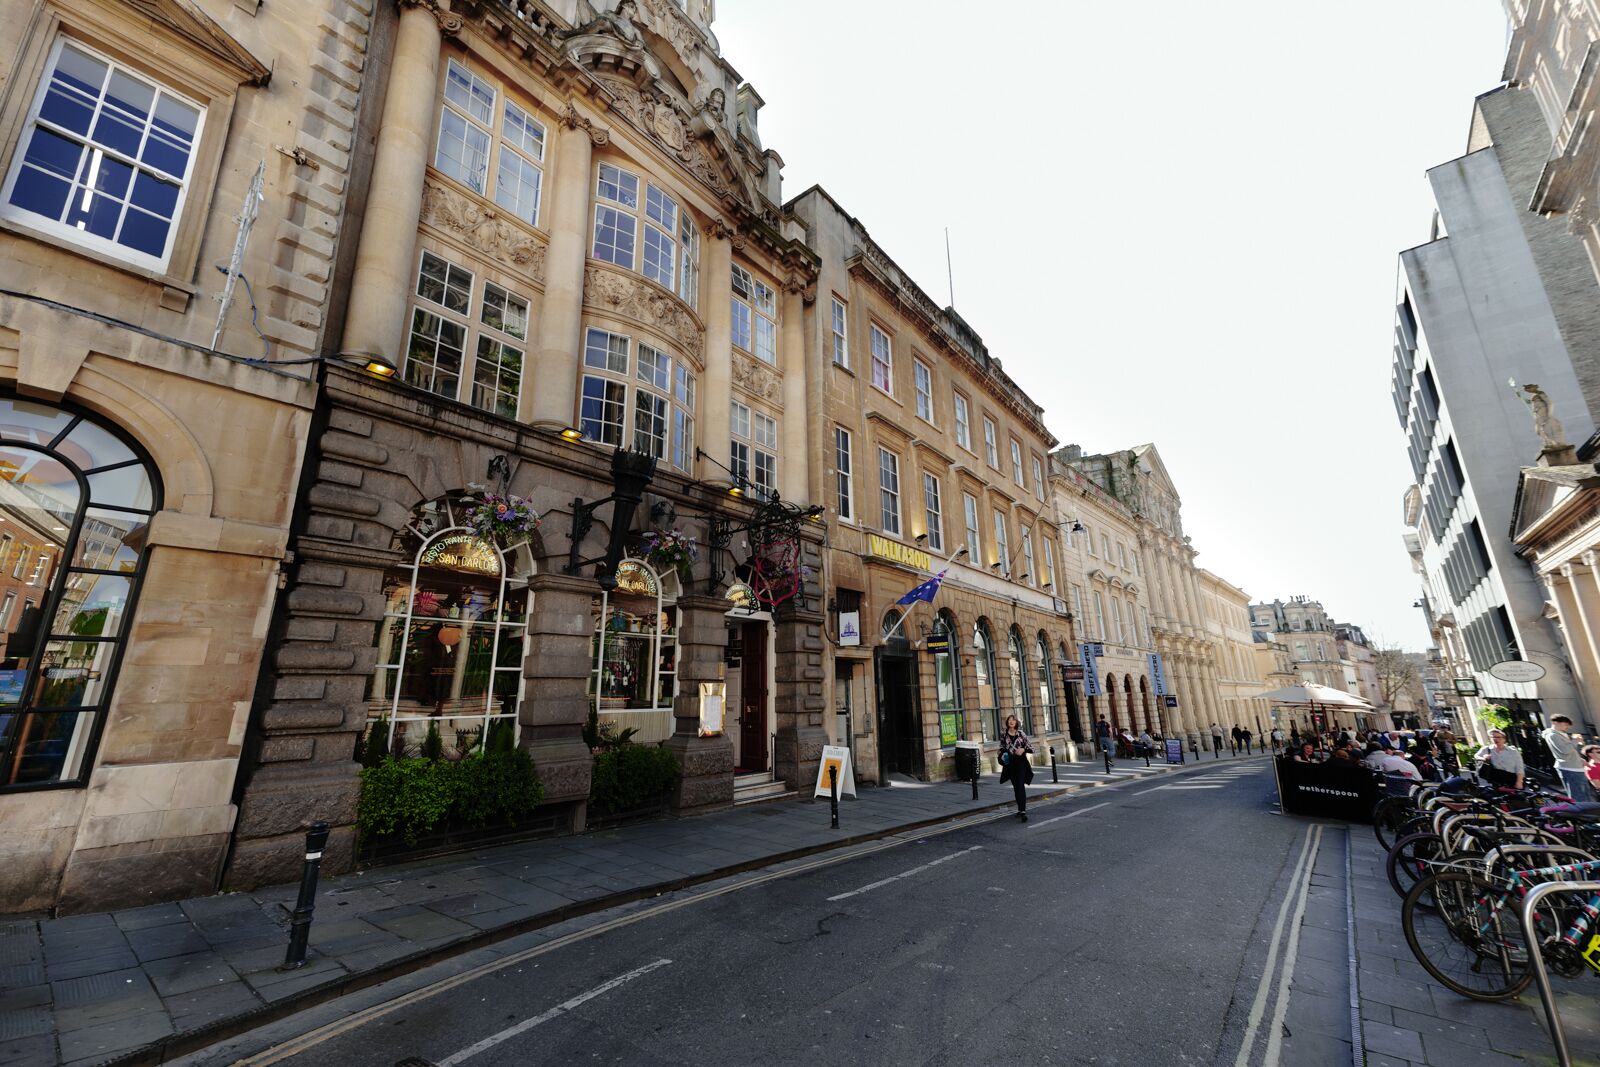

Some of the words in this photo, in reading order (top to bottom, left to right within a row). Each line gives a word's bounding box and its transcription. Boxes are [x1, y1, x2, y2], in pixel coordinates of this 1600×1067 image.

[439, 552, 458, 565] SAN
[461, 556, 489, 570] CARLO
[871, 535, 930, 572] WALKABOUT
[617, 578, 629, 589] SAN
[630, 580, 650, 591] CARLO
[1083, 645, 1091, 668] NERO
[1298, 785, 1359, 798] wetherspoon
